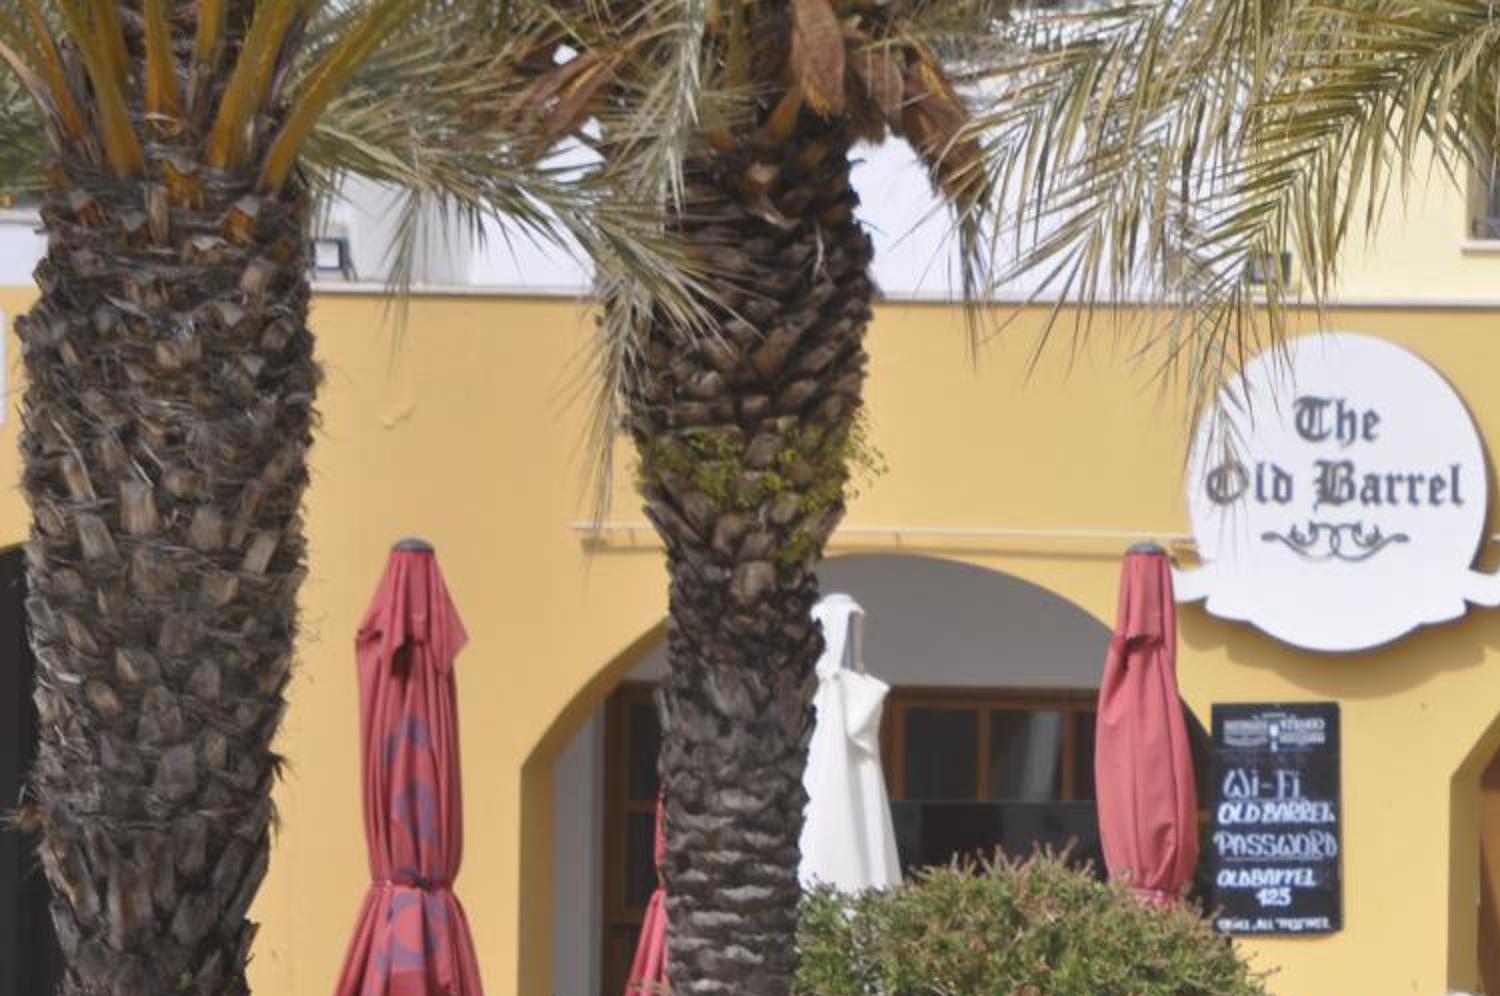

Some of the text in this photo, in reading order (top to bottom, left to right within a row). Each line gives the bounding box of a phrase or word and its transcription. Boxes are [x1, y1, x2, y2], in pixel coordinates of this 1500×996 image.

[1292, 395, 1381, 447] The
[1206, 459, 1464, 512] Old Barrel
[1223, 767, 1300, 800] Wi-Fi
[1217, 801, 1260, 825] OLD
[1213, 829, 1337, 857] PASSWORD
